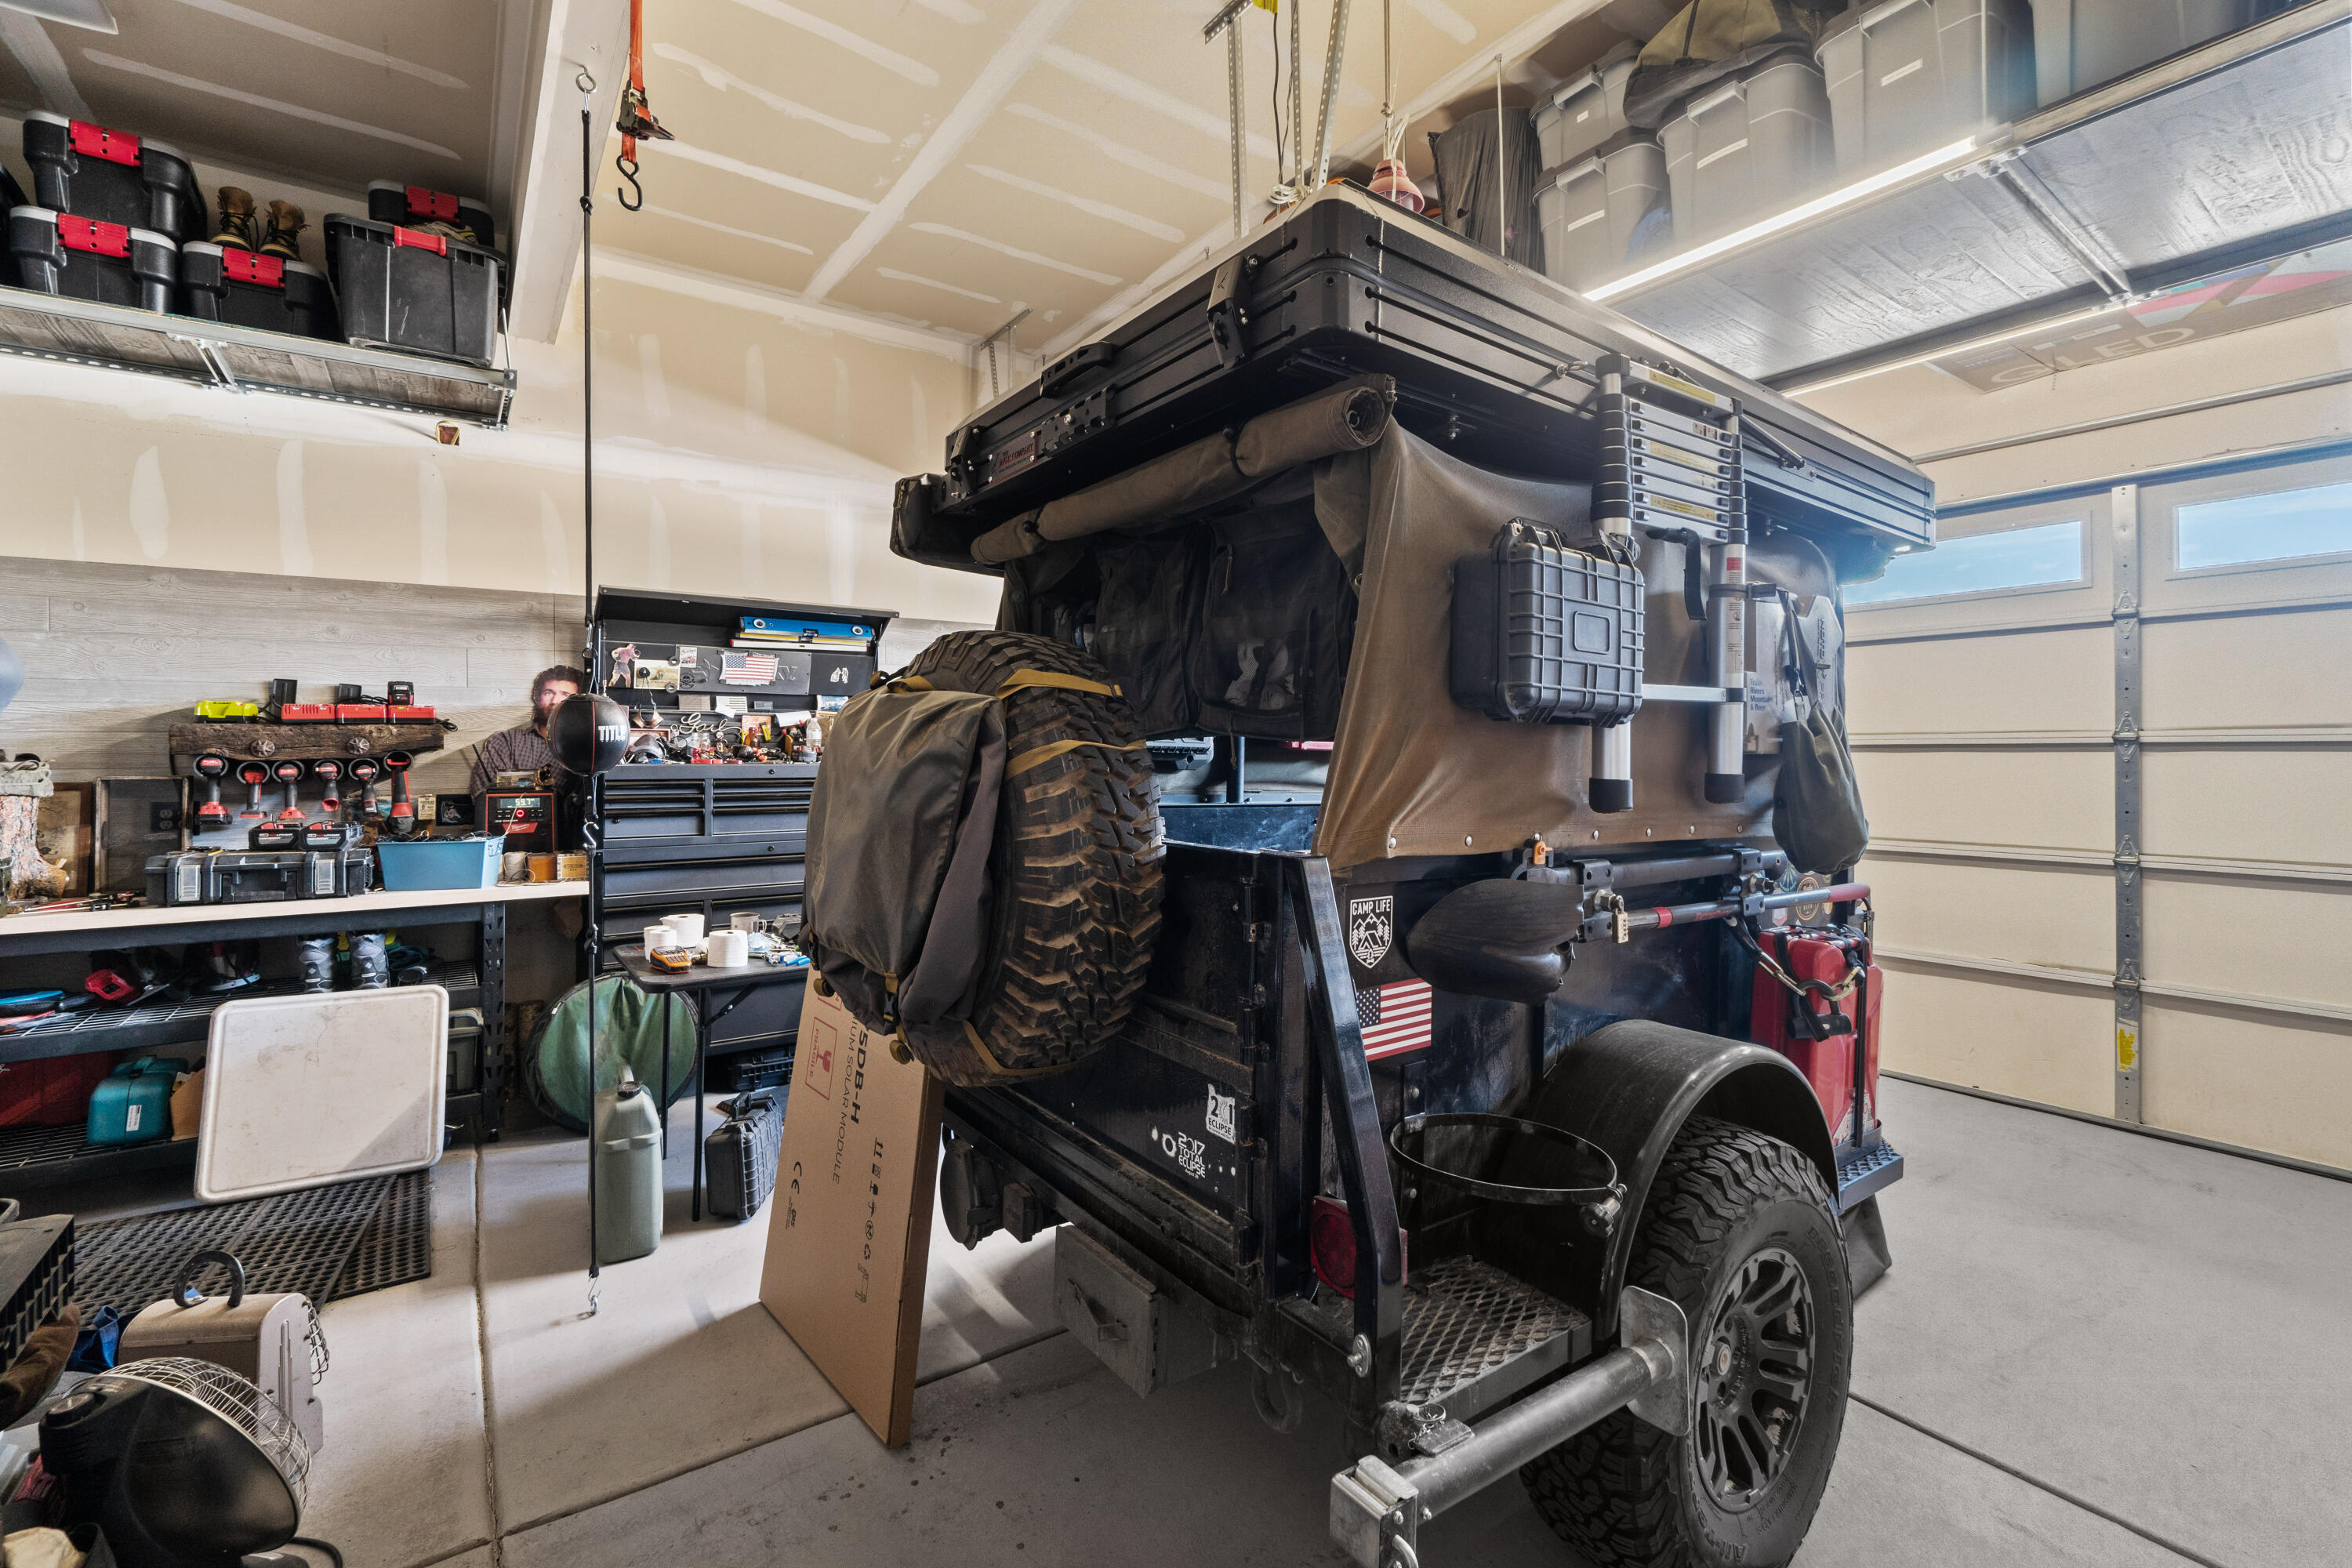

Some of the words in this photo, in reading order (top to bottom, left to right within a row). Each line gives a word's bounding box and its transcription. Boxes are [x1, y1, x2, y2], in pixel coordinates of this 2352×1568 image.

[1991, 328, 2195, 383] QLED
[1750, 687, 1765, 695] Rivers
[1750, 695, 1773, 703] Mountains
[598, 725, 626, 742] TITLE
[1352, 901, 1374, 915] CAMP
[1375, 899, 1391, 913] LIFE
[809, 1028, 819, 1078] FRAGILE
[842, 1054, 853, 1109] SOLAR
[851, 1029, 869, 1124] 5DB-H
[1208, 1117, 1232, 1135] ECLIPSE
[833, 1111, 848, 1185] MODULE
[1178, 1131, 1205, 1155] 2017
[1178, 1145, 1205, 1167] TOTAL
[1178, 1155, 1206, 1178] ECLIPSE
